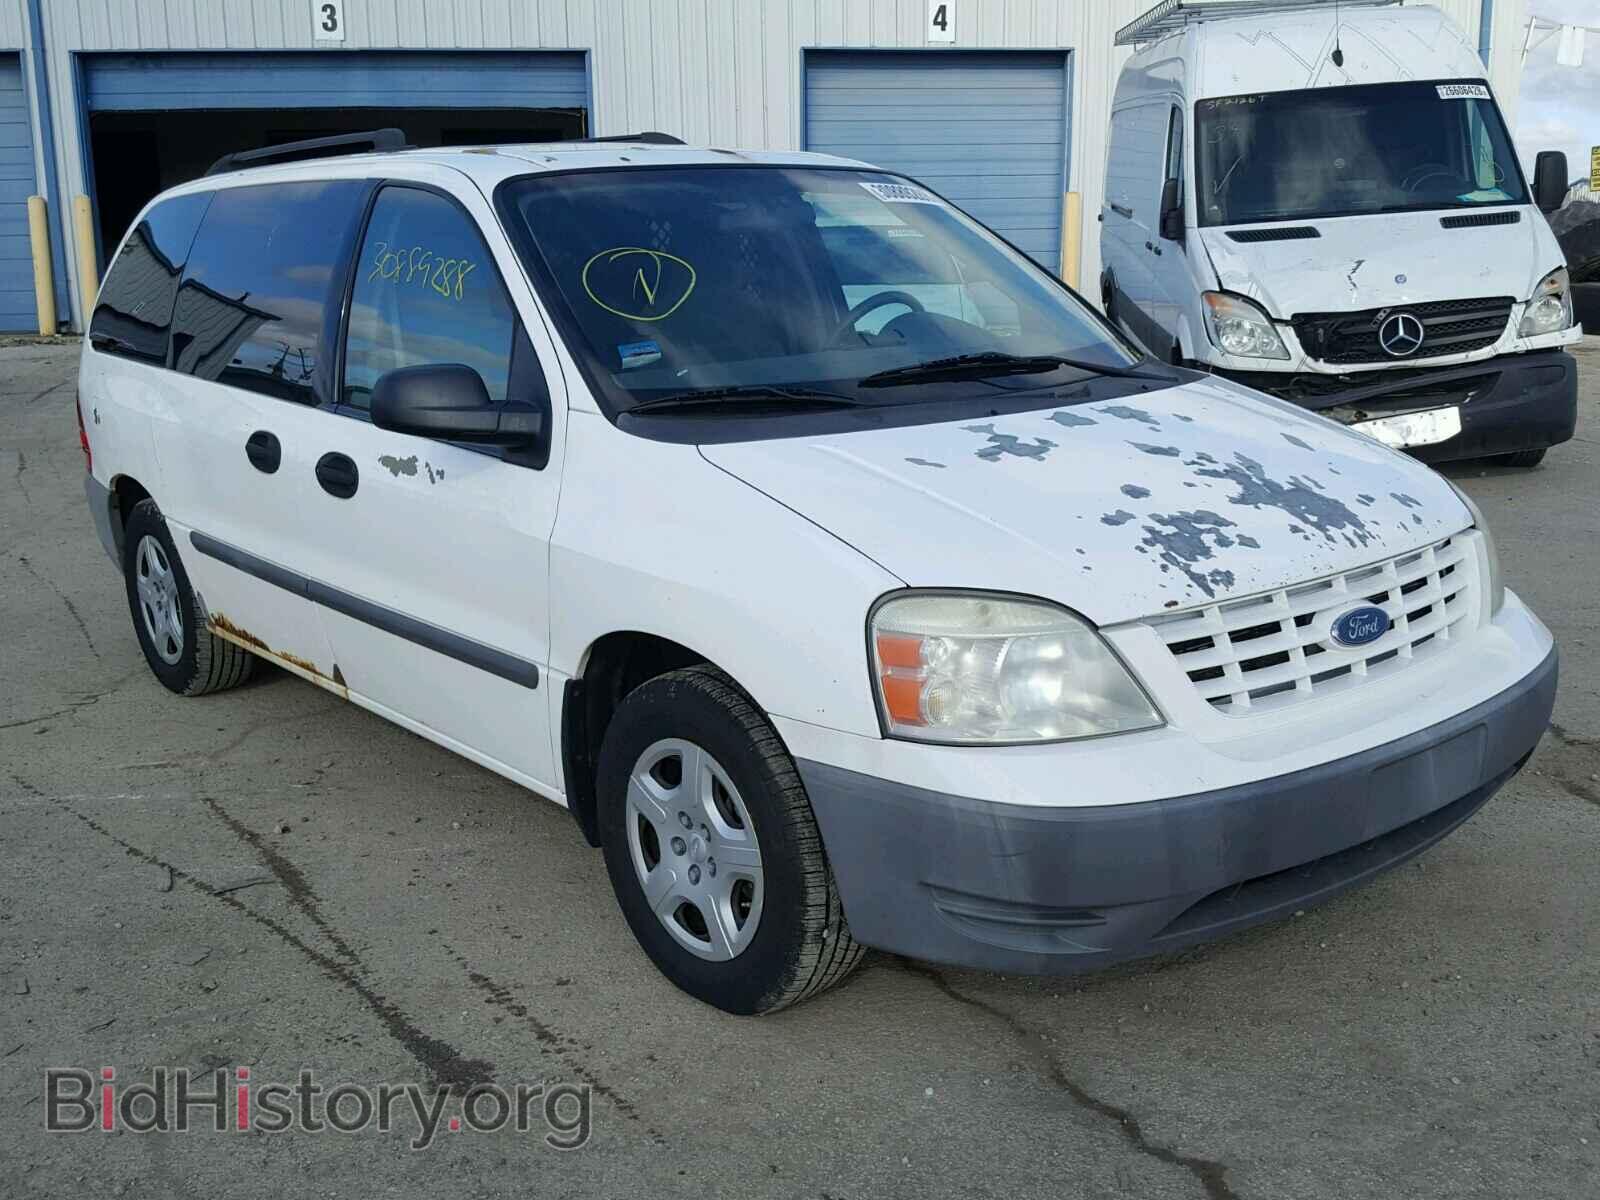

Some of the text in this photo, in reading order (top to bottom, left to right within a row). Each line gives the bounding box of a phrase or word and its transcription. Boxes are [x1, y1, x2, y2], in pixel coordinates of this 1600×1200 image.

[321, 3, 338, 32] 3
[932, 4, 948, 31] 4
[368, 241, 476, 300] 30889288
[1348, 614, 1379, 639] Ford
